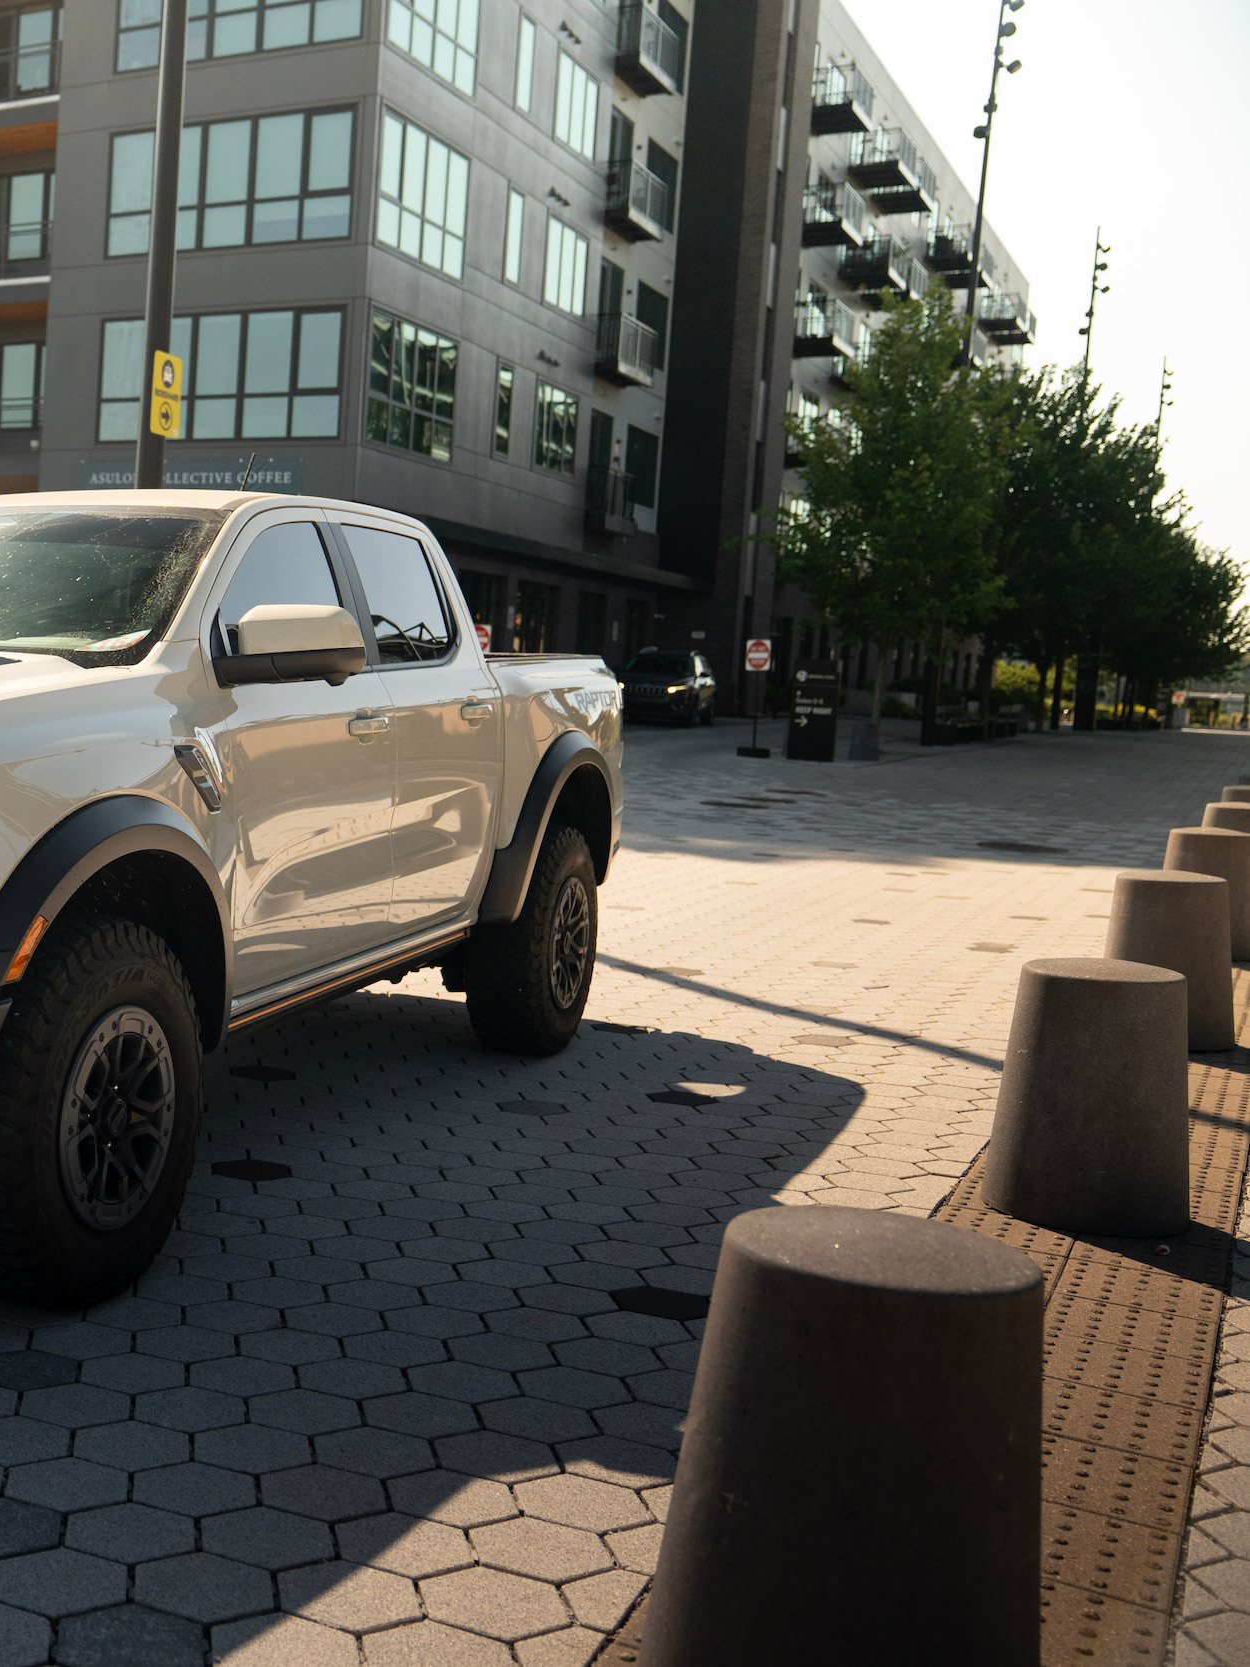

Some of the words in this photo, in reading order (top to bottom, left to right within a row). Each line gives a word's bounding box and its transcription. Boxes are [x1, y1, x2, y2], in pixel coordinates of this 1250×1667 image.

[89, 472, 136, 485] ASULO
[236, 471, 292, 485] COFFEE
[574, 690, 619, 712] RAPTOR
